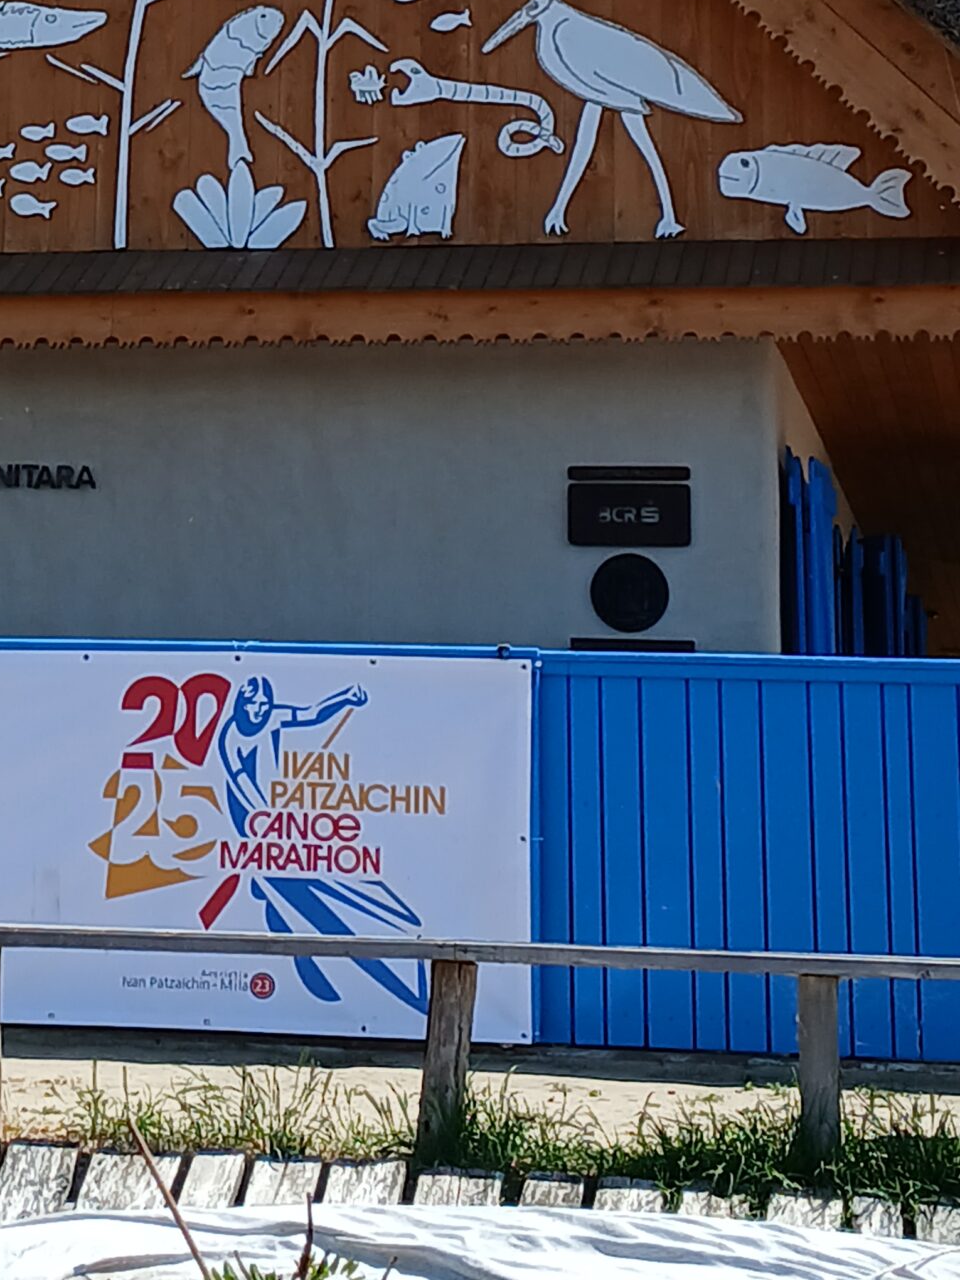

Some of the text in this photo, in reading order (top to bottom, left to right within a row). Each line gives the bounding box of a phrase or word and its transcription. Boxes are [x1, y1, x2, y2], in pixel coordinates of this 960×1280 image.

[121, 673, 232, 769] 20
[282, 751, 350, 780] IVAN
[270, 781, 446, 815] PATZAICHIN
[220, 841, 381, 874] MARATHON
[122, 975, 146, 988] Ivan
